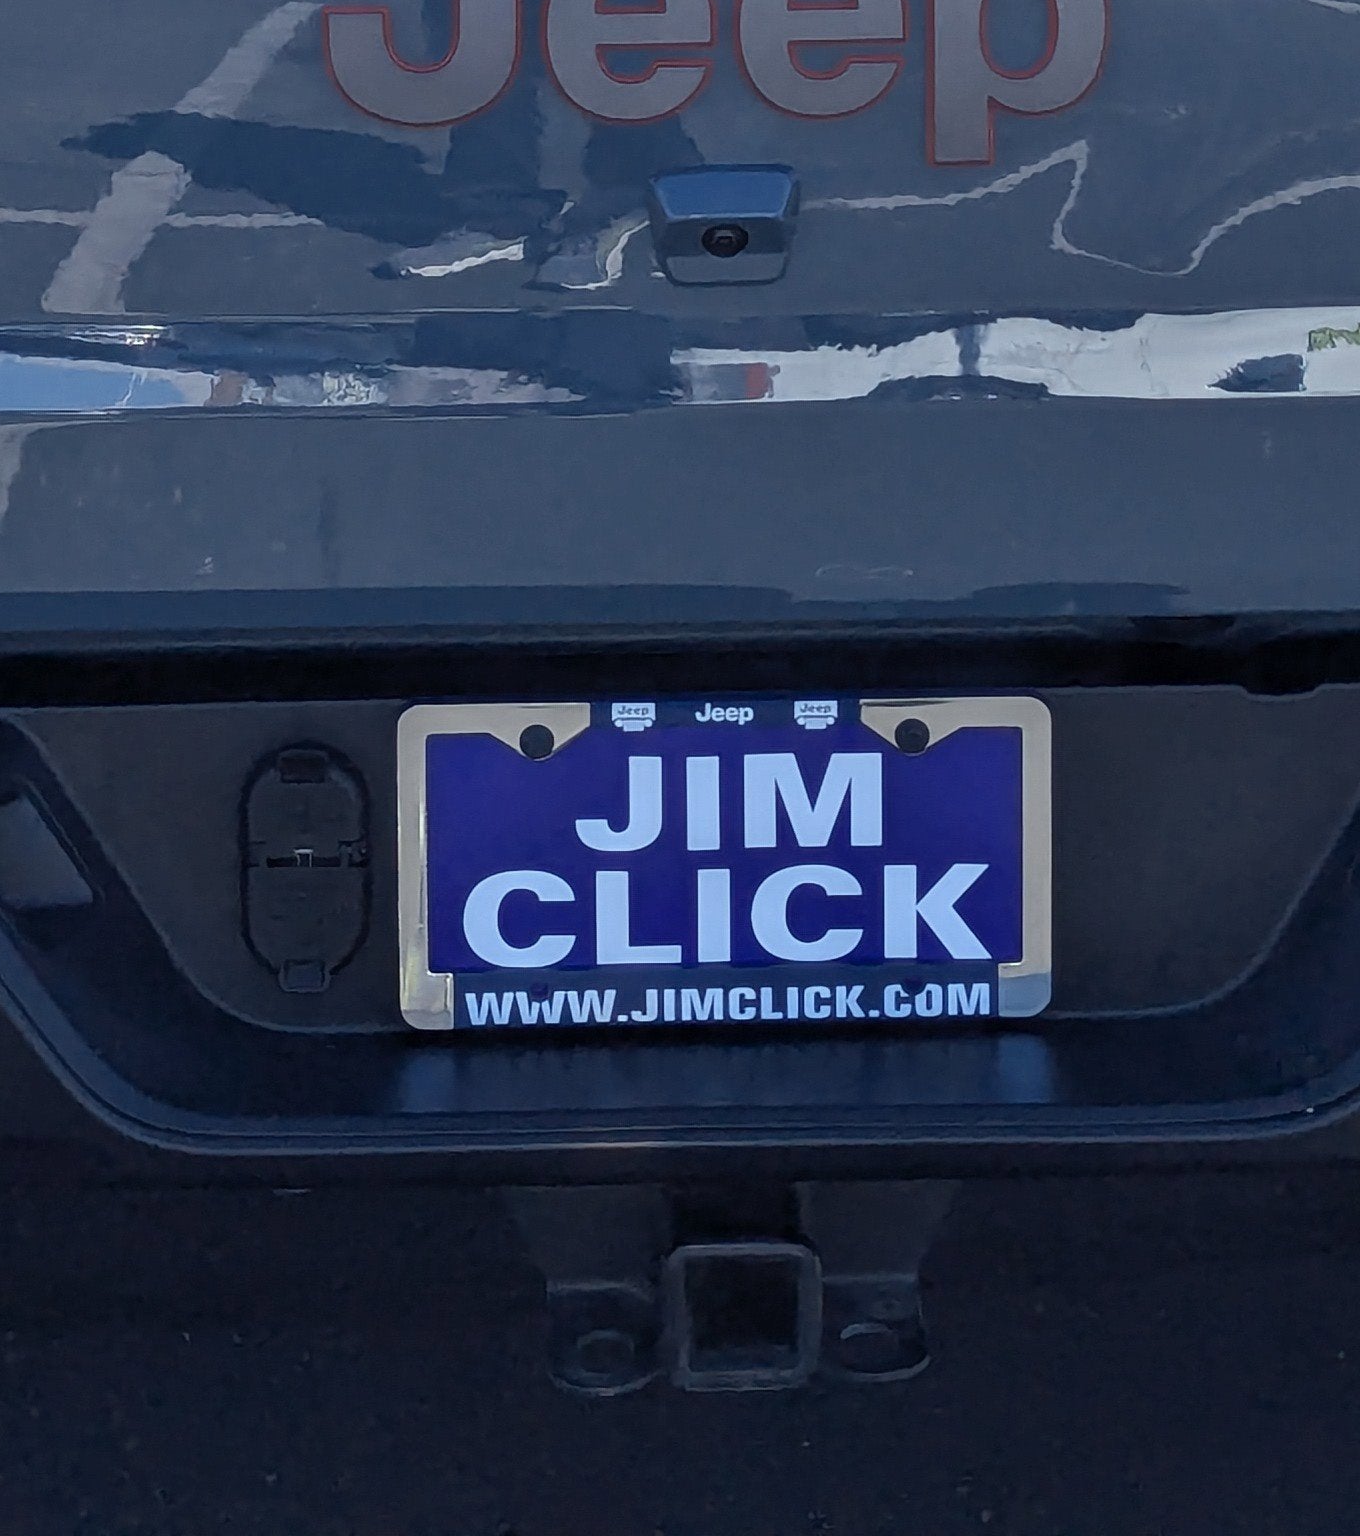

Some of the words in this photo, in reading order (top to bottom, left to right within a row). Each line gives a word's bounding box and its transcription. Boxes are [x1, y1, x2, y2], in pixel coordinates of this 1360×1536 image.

[695, 702, 754, 725] Jeep
[575, 752, 882, 851] JIM
[462, 864, 992, 968] CLICK
[465, 982, 991, 1026] WWW.JIMCLICK.COM
